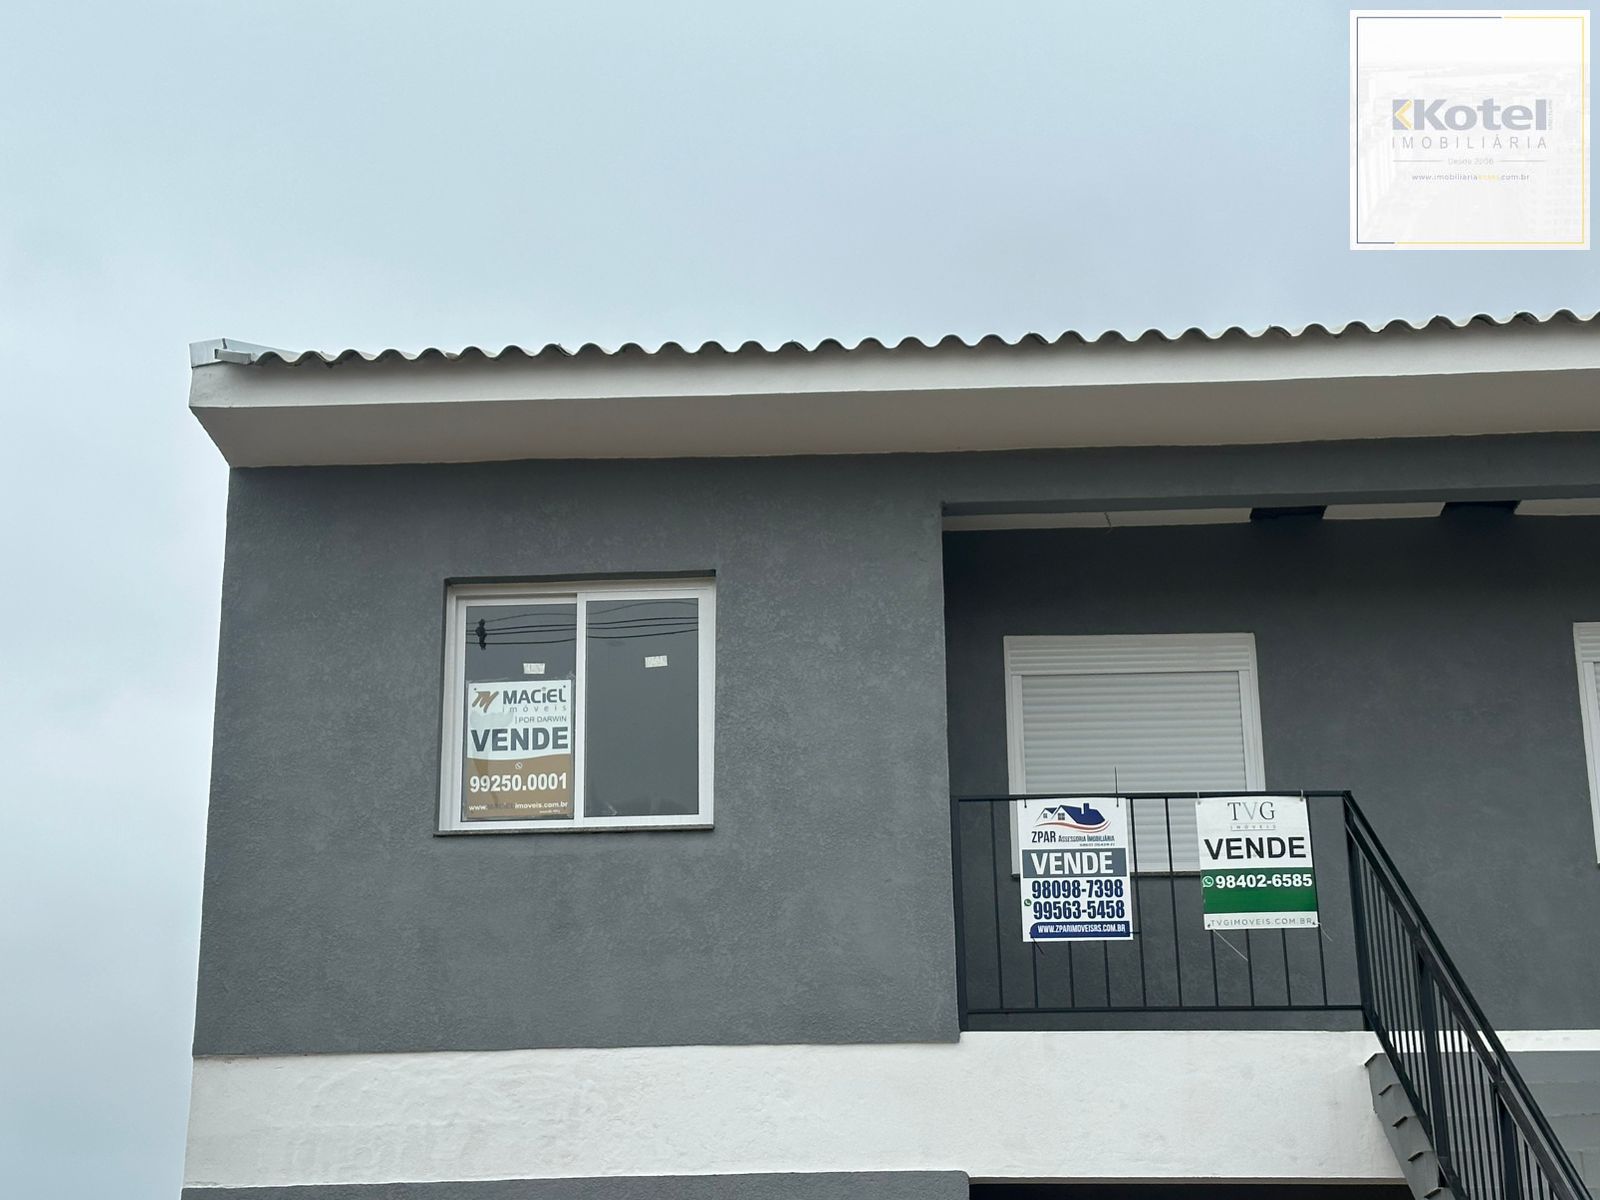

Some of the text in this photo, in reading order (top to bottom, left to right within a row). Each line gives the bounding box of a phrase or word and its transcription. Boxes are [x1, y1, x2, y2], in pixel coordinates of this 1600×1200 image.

[536, 715, 567, 723] DARWIN
[470, 727, 568, 752] VENDE
[469, 772, 567, 793] 99250.0001
[468, 800, 568, 811] www.imoveis.com.br
[1227, 801, 1275, 820] TVG
[1031, 831, 1056, 843] ZPAR
[1203, 837, 1306, 860] VENDE
[1030, 851, 1114, 875] VENDE
[1031, 879, 1124, 899] 98098-7398
[1215, 874, 1313, 889] 98402-6585
[1033, 900, 1125, 920] 99563-5458
